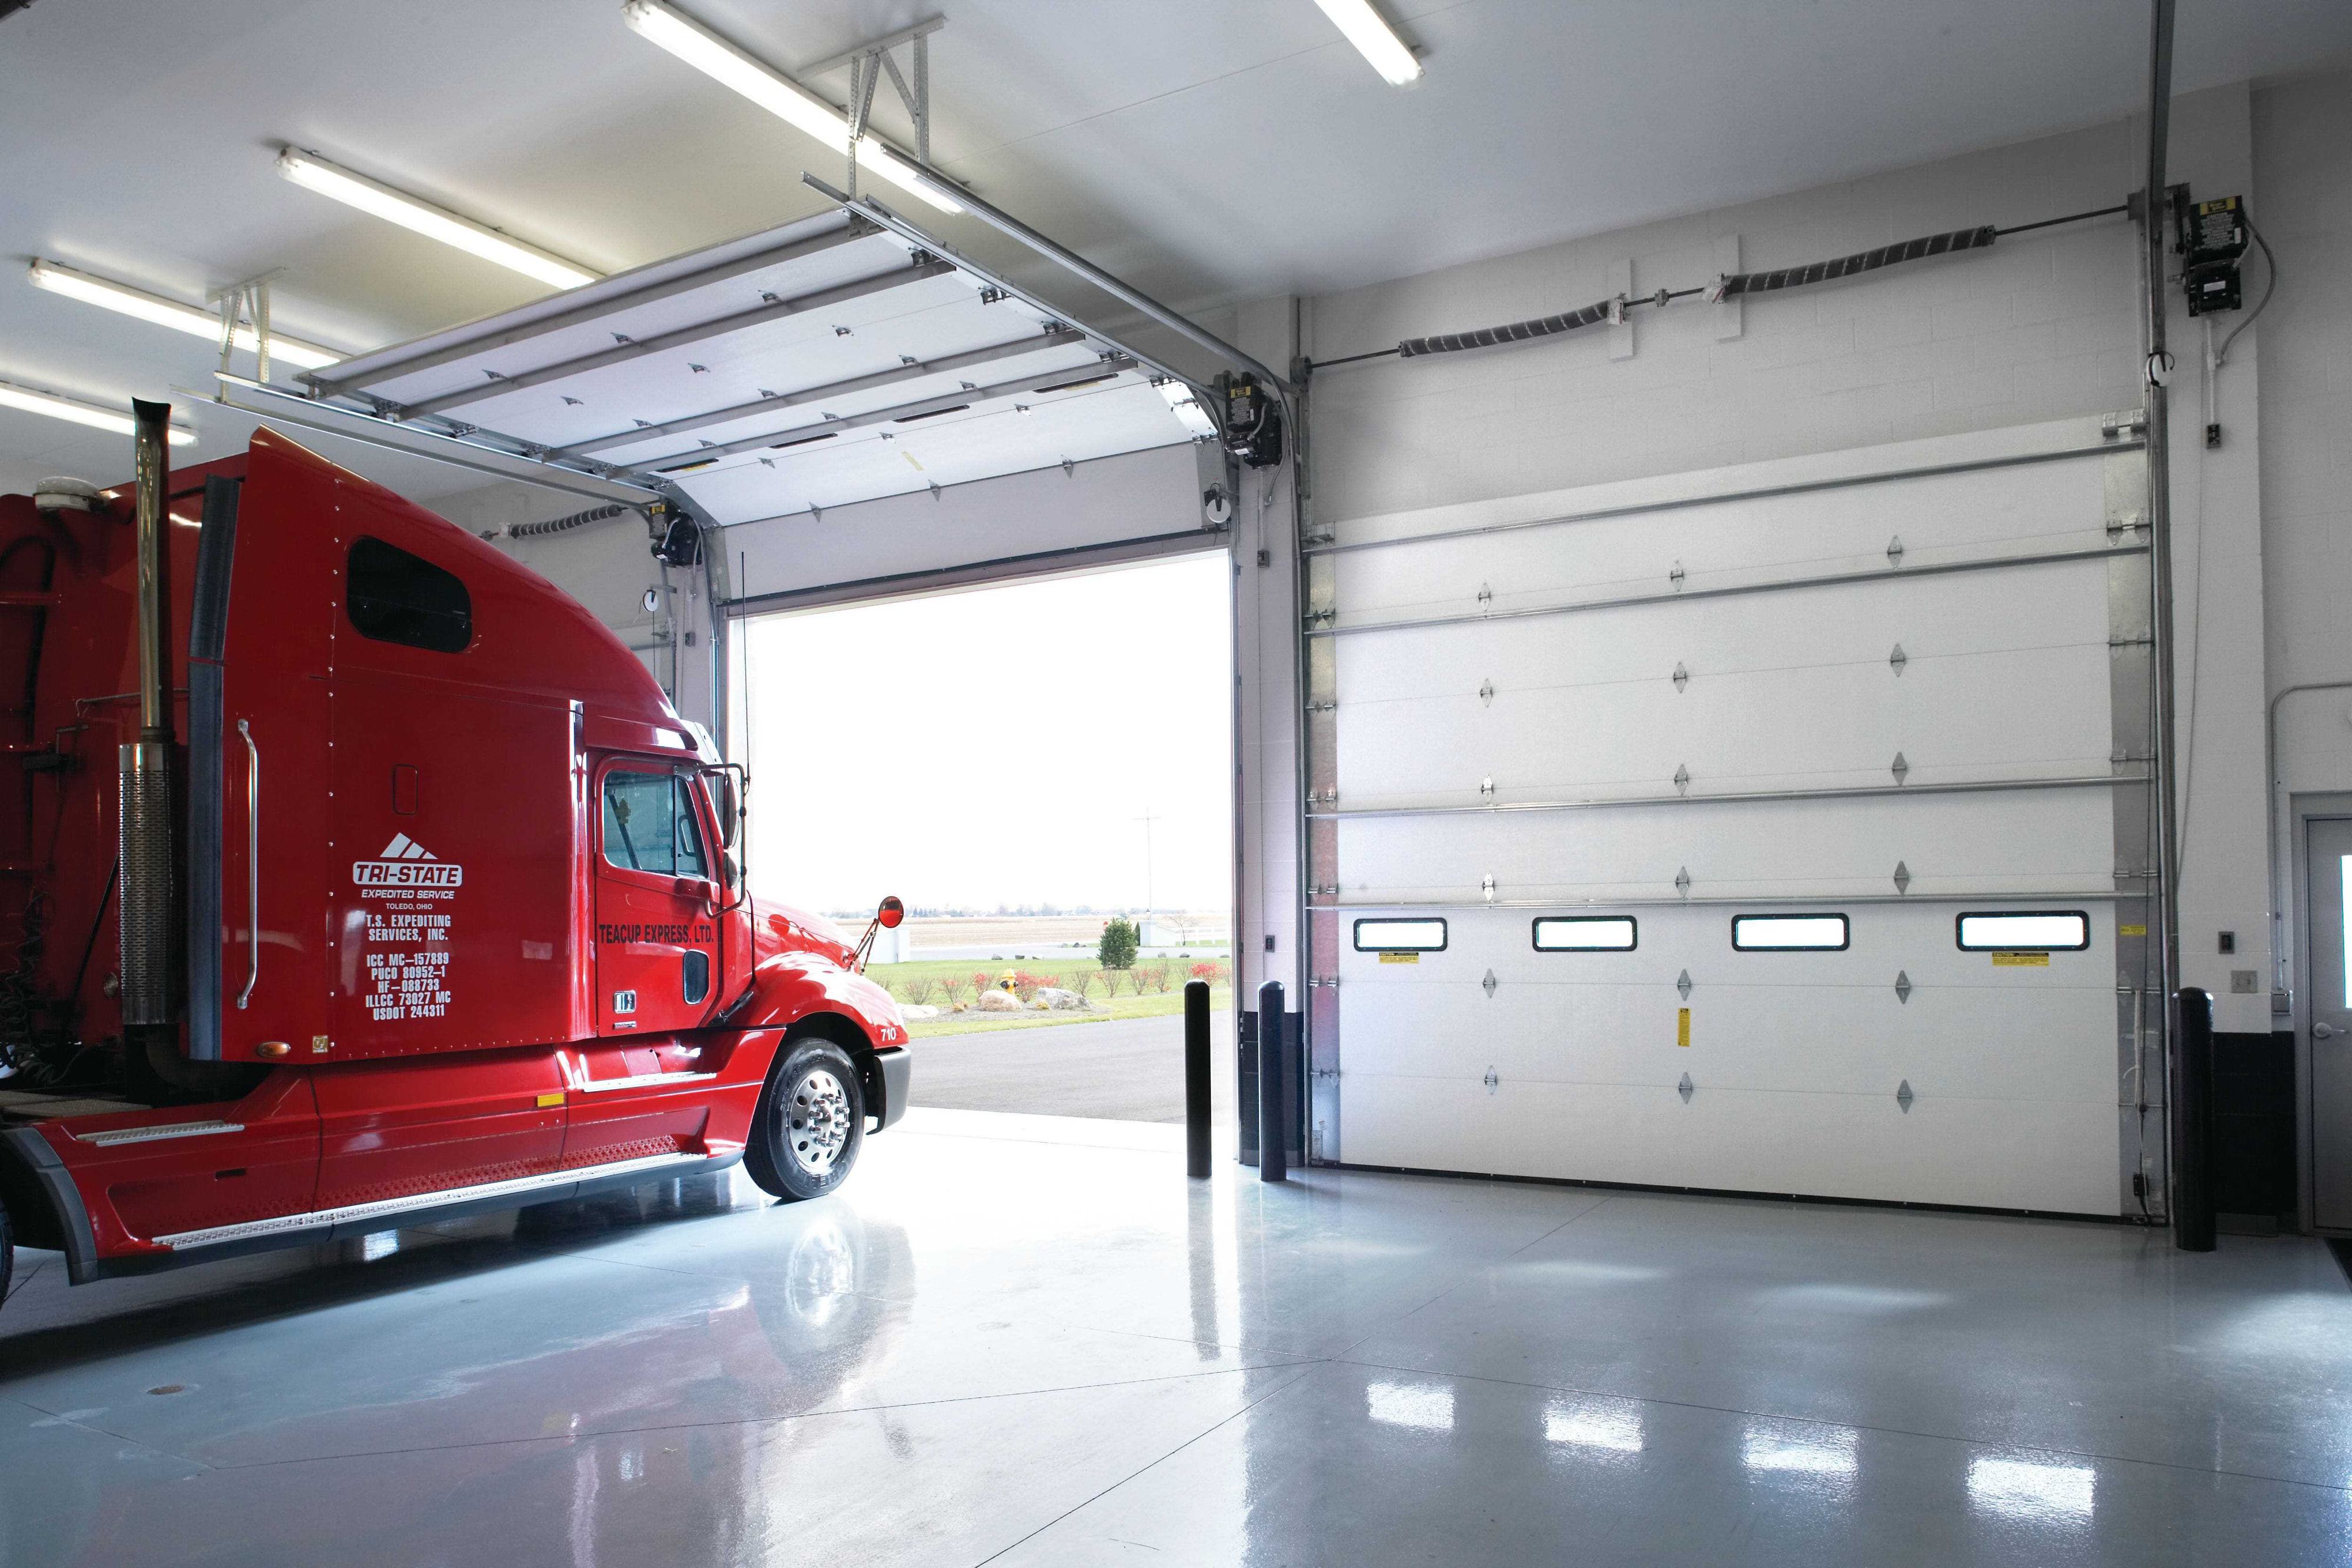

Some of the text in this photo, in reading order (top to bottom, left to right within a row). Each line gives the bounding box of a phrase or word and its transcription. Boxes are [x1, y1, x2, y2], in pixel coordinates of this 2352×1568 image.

[357, 865, 458, 884] TRI-STATE
[362, 889, 455, 899] EXPEDITED SERVICE
[366, 915, 451, 927] T.S. EXPEDITING
[369, 928, 448, 942] SERVICES, INC.
[599, 924, 714, 947] TEACUP EXPRESS, LTD.
[367, 954, 384, 967] ICC
[372, 967, 397, 980] PUCO
[366, 991, 451, 1007] ILLCC 73027 MC
[373, 1005, 445, 1020] USDOT 244311
[881, 1028, 896, 1041] 710
